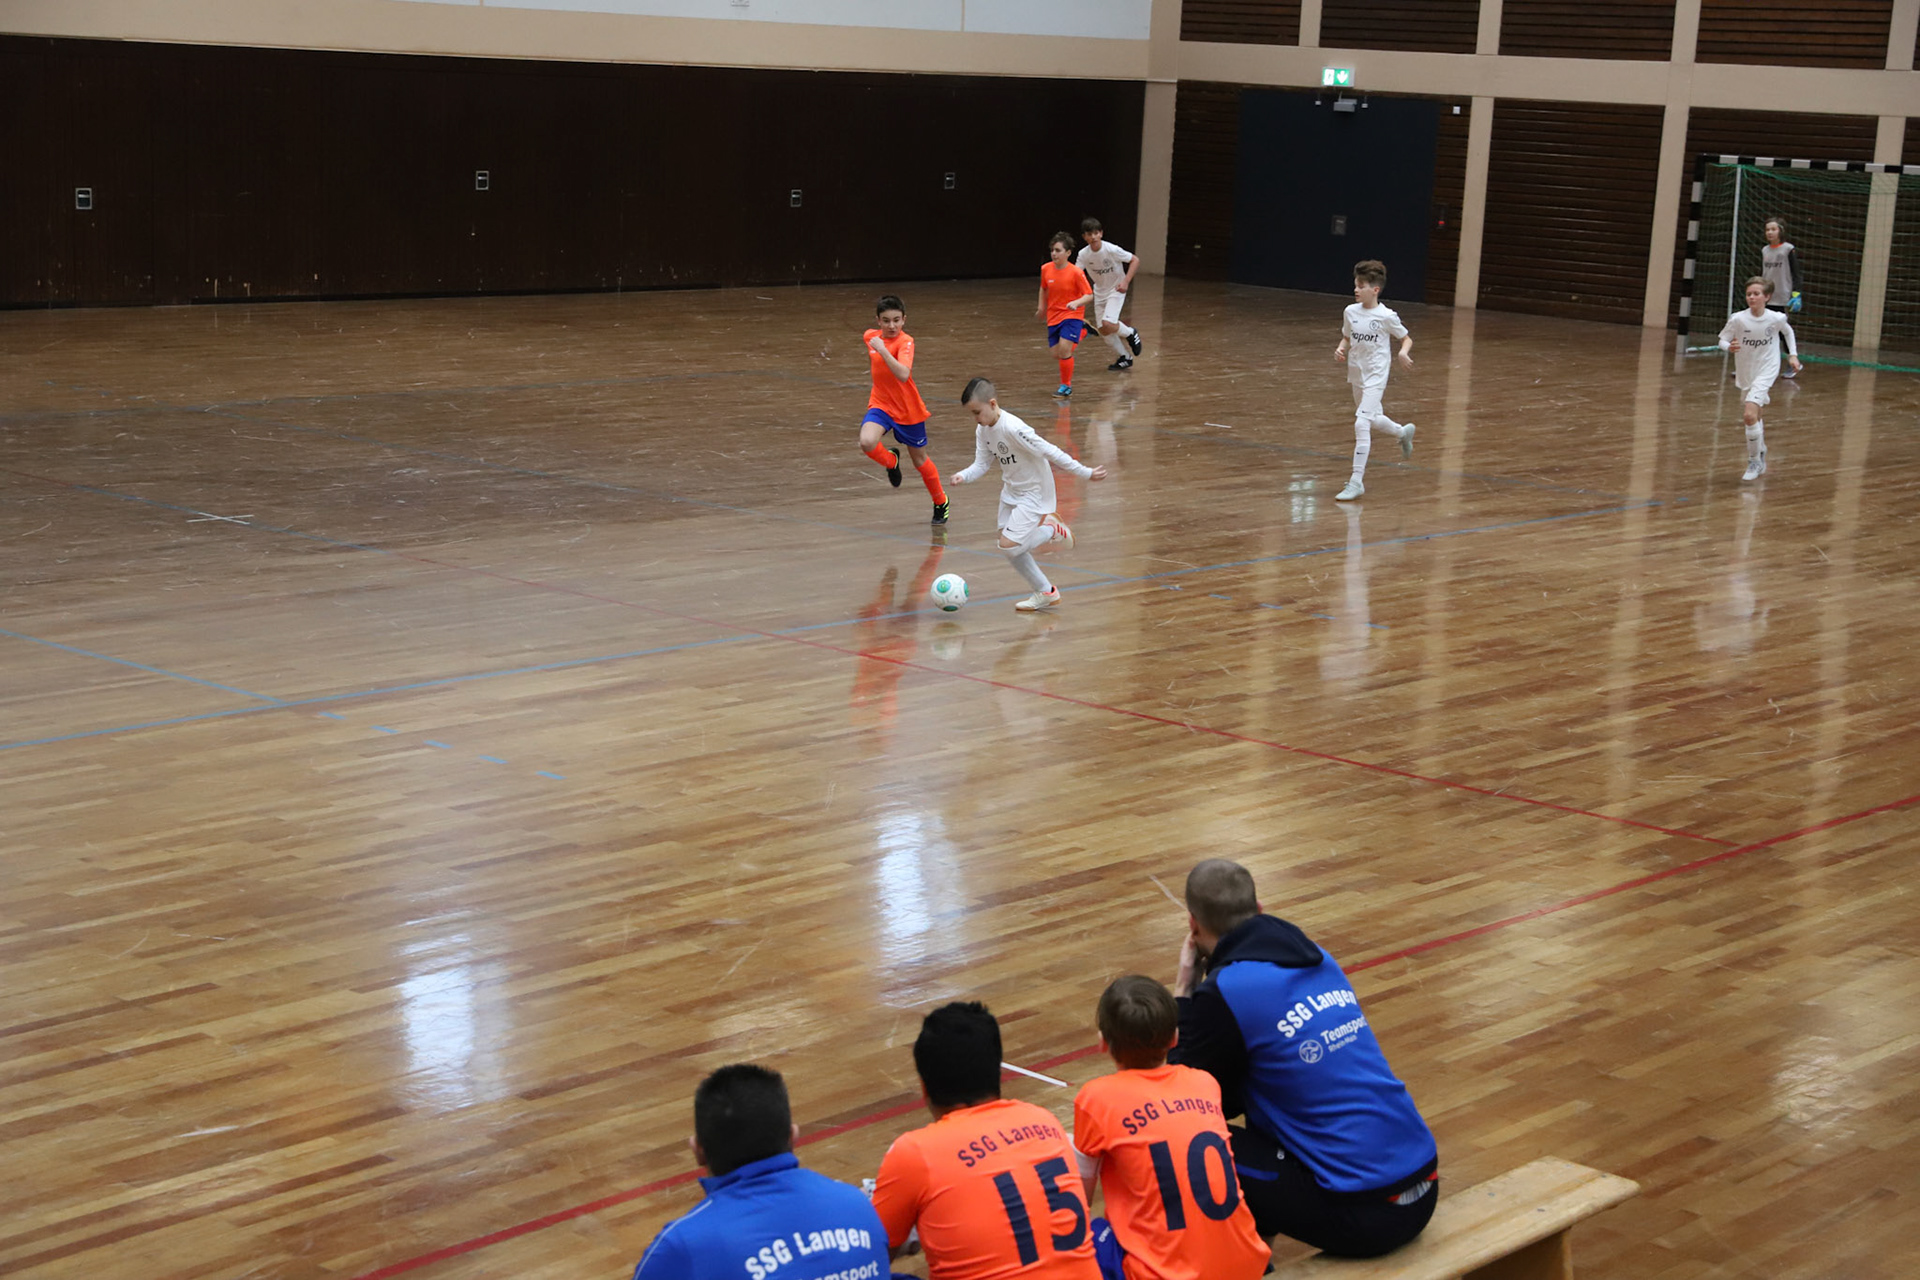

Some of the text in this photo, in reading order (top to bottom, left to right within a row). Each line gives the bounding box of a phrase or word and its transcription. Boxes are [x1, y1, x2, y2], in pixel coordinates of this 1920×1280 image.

[1277, 990, 1357, 1038] SSG Langen
[1122, 1097, 1222, 1136] SSG Langen
[958, 1124, 1062, 1168] SSG Langen
[1149, 1131, 1240, 1231] 10
[992, 1156, 1087, 1267] 15
[745, 1227, 872, 1280] SSG Langen
